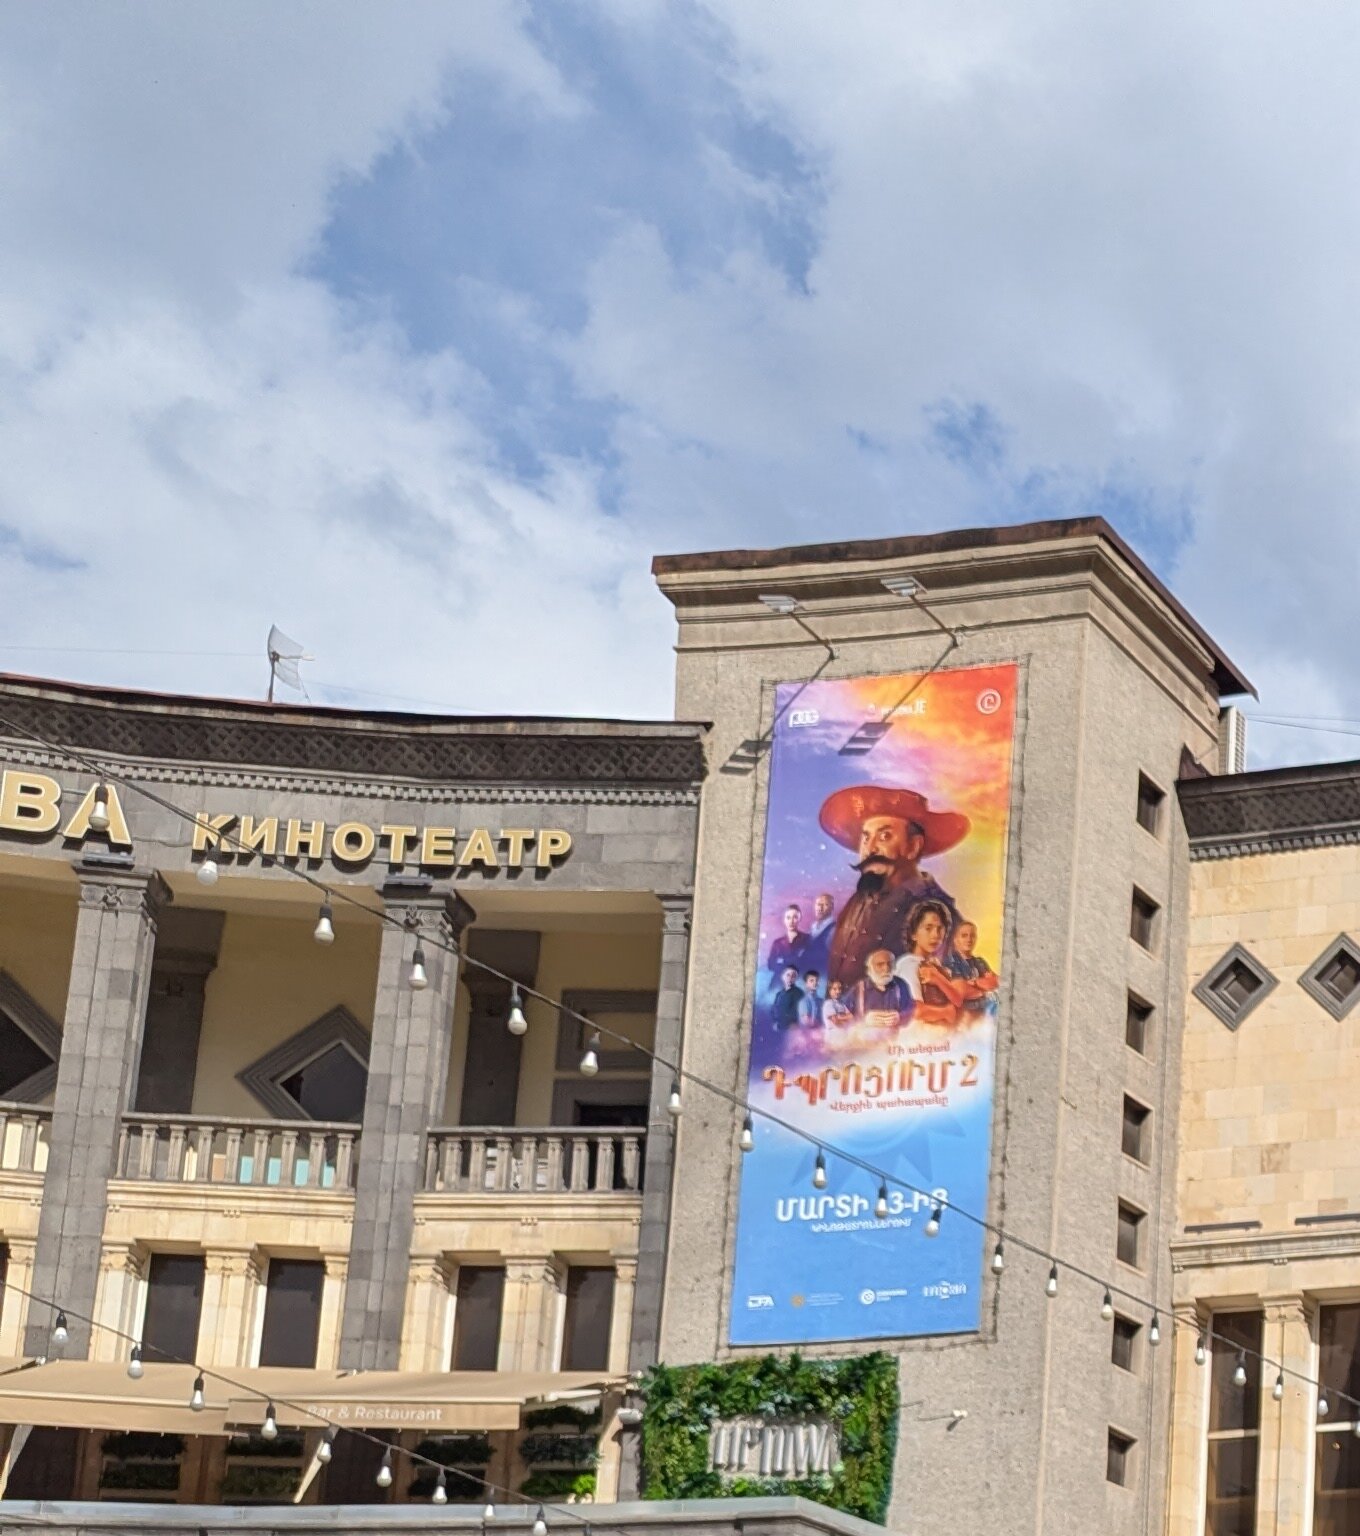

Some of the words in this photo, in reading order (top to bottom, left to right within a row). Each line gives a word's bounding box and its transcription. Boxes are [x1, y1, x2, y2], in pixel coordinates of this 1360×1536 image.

[0, 769, 132, 845] ВА
[193, 812, 573, 868] КИНОТЕАТР
[960, 1053, 979, 1087] 2
[776, 1192, 869, 1222] ՄԱՐՏԻ
[306, 1405, 332, 1420] Bar
[337, 1406, 350, 1419] &
[355, 1406, 443, 1421] Restaurant
